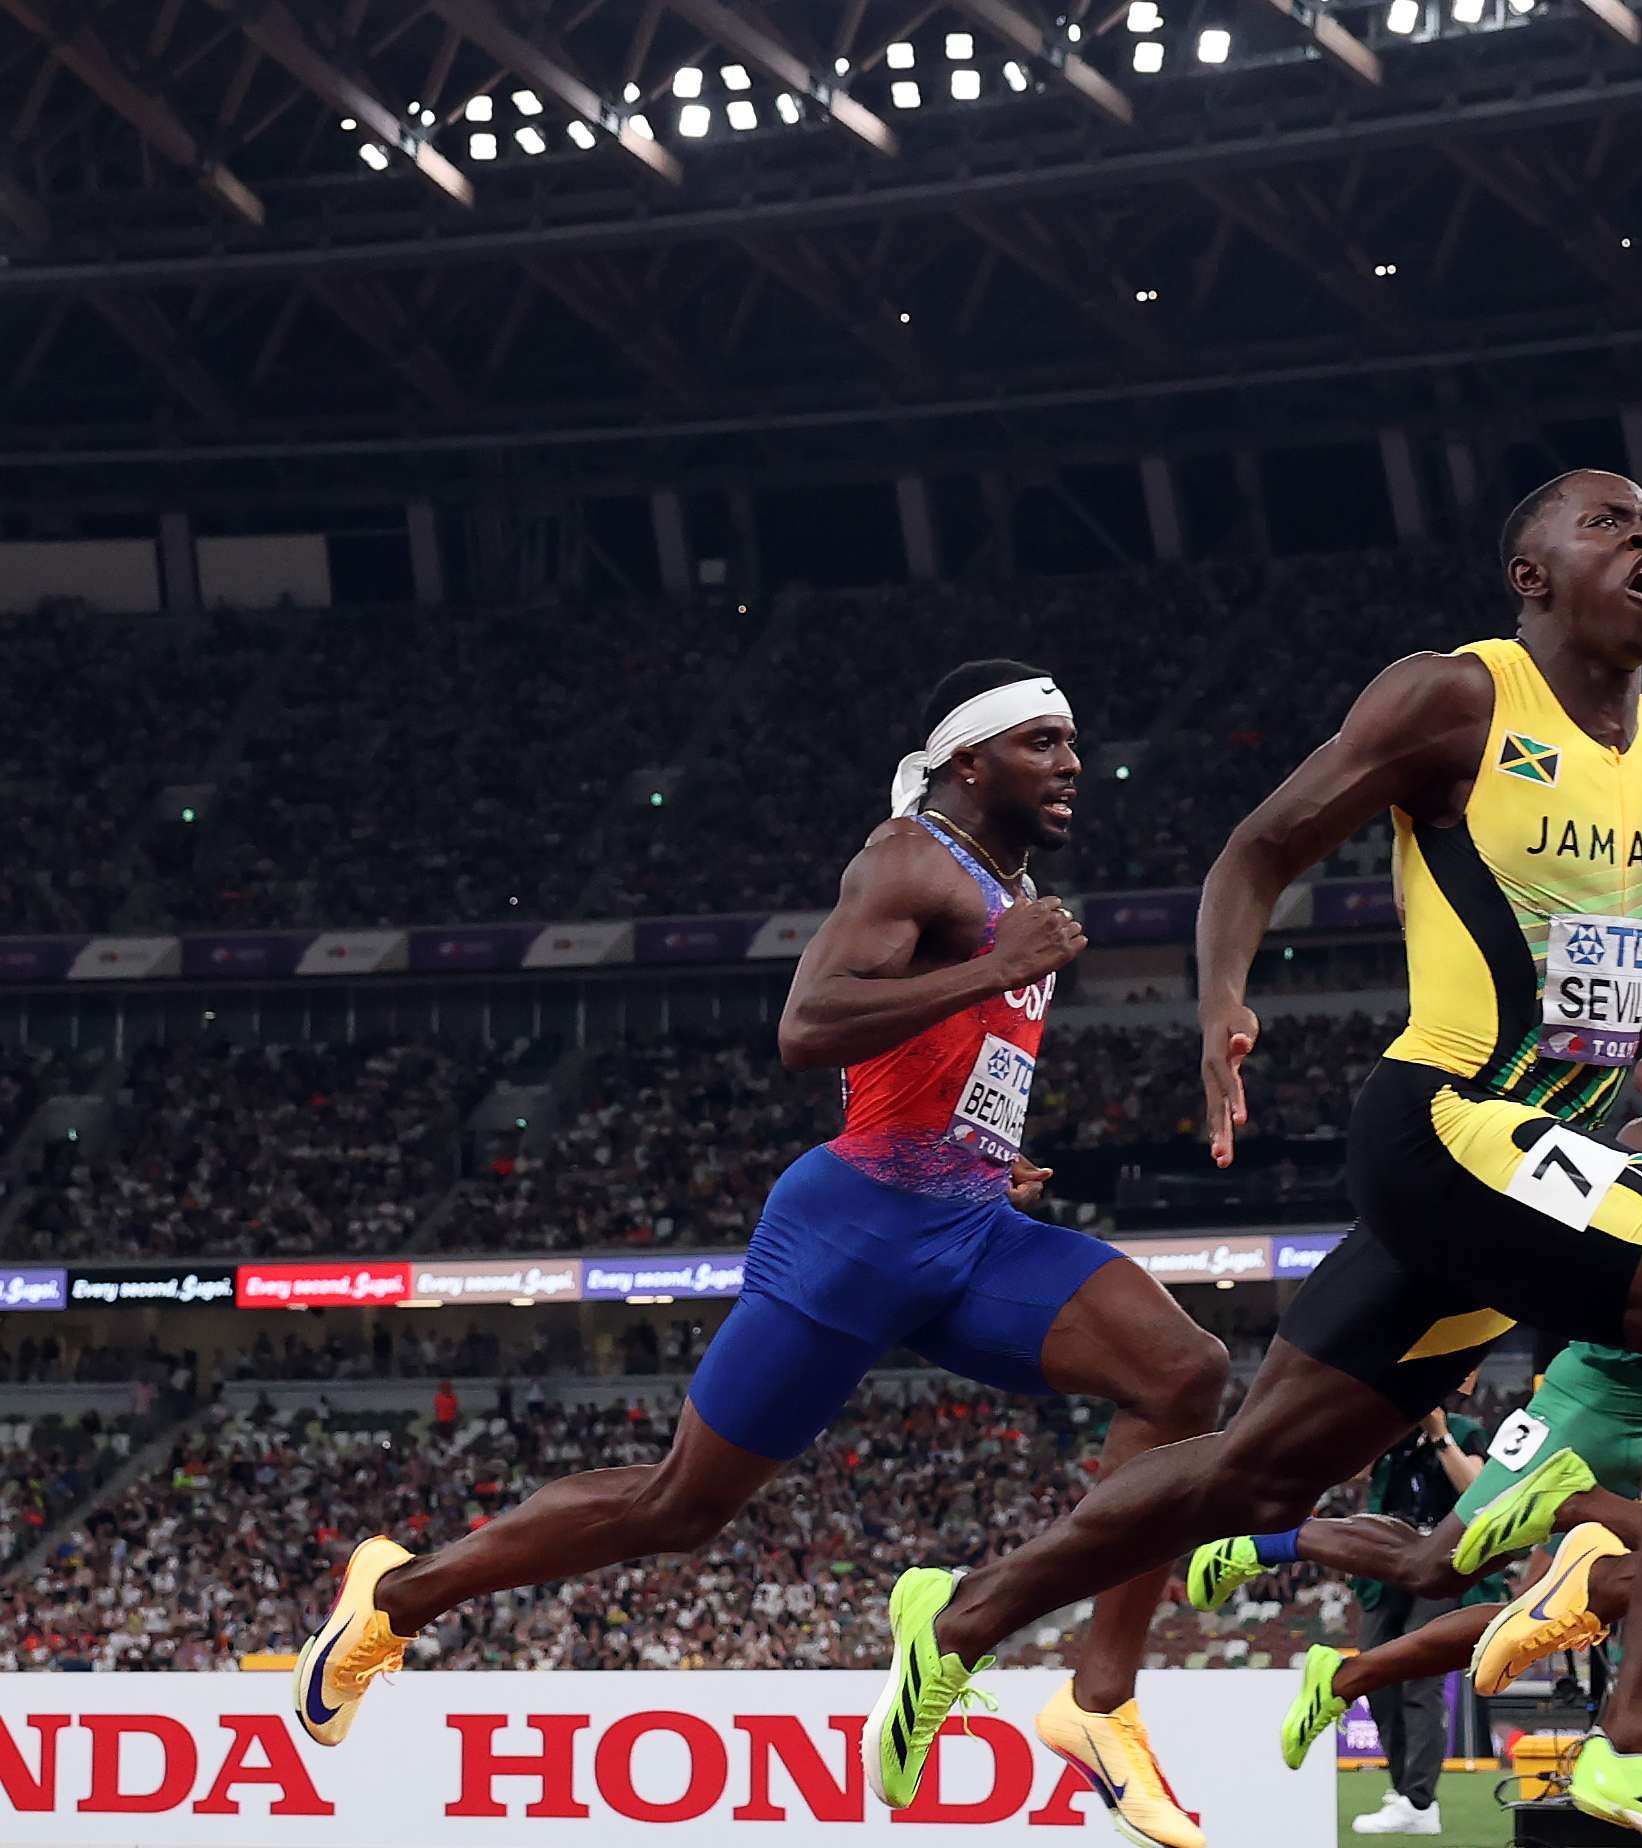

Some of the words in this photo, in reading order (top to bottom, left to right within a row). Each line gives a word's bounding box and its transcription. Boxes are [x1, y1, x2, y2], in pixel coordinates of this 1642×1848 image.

[1532, 1144, 1592, 1198] 7
[1503, 1424, 1530, 1456] 3
[0, 1713, 336, 1816] NDA
